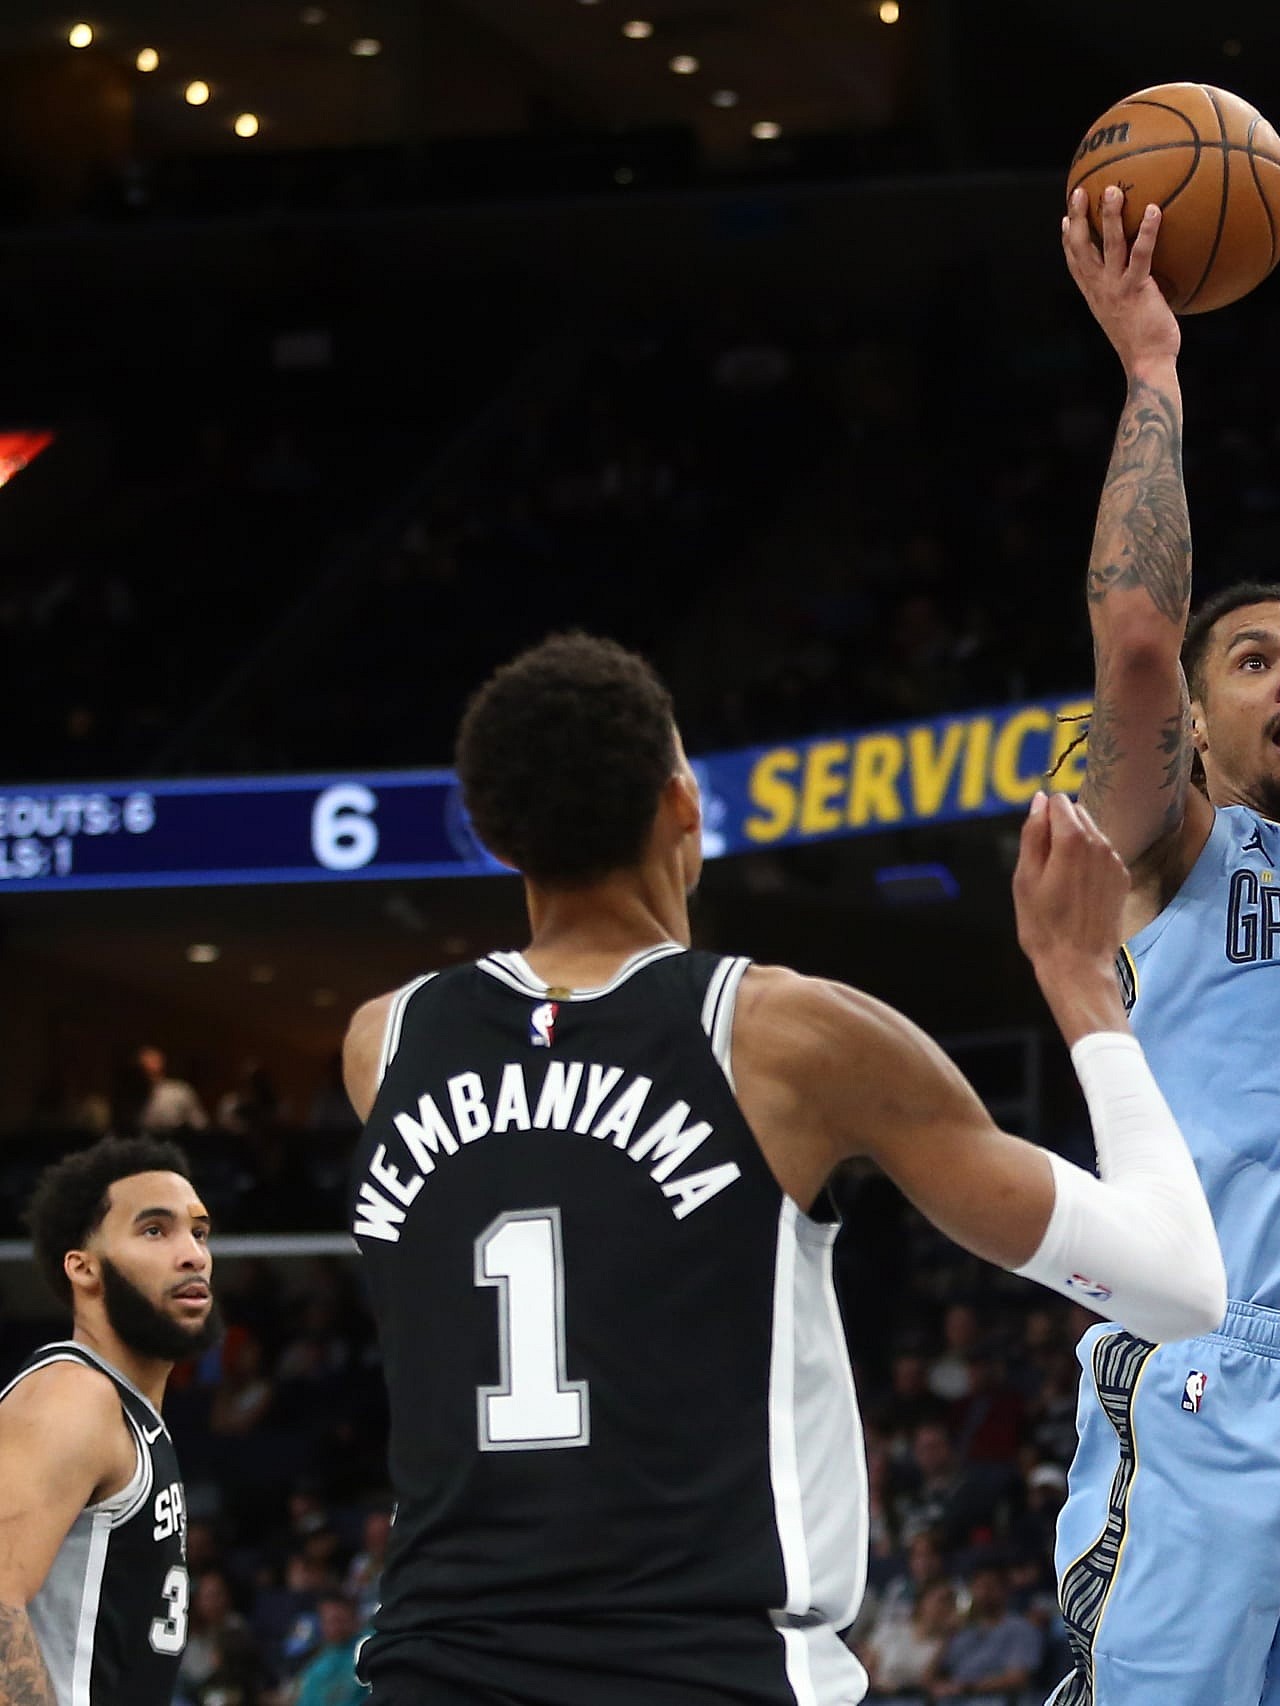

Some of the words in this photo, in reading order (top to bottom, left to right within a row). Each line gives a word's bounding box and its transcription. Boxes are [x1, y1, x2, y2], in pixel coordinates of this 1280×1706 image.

[122, 792, 156, 834] 6
[745, 699, 1093, 843] SERVICE
[54, 836, 73, 877] 1
[310, 782, 380, 871] 6
[353, 1061, 742, 1243] WEMBANYAMA
[473, 1206, 591, 1453] 1
[149, 1563, 191, 1656] 3
